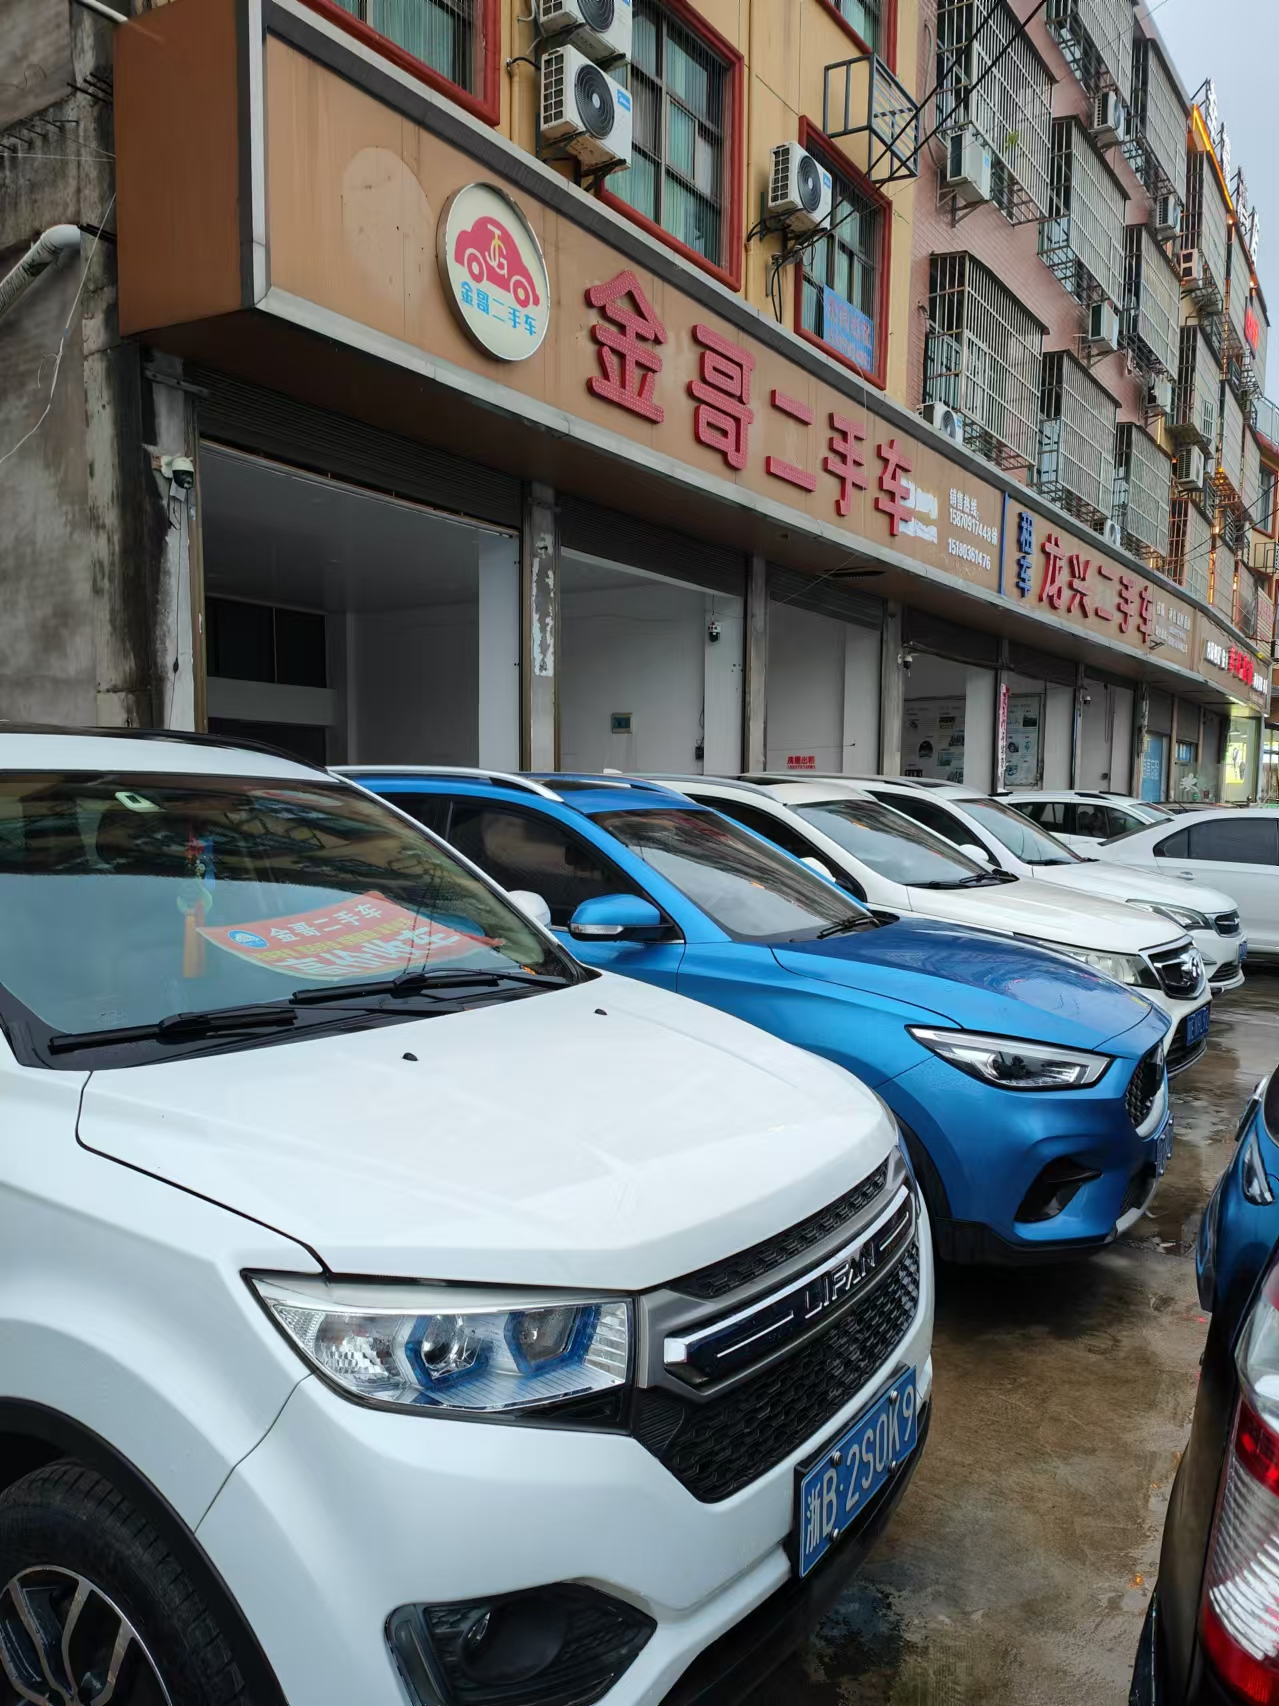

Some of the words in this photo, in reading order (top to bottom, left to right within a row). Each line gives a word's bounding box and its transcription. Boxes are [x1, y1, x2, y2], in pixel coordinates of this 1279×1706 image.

[460, 281, 537, 337] 金哥二手车
[585, 269, 914, 537] 金哥二手车
[1039, 533, 1153, 644] 龙兴二手车
[269, 903, 382, 943] 金哥二手车
[274, 926, 461, 974] 高价收车
[804, 1240, 877, 1319] LIFAN
